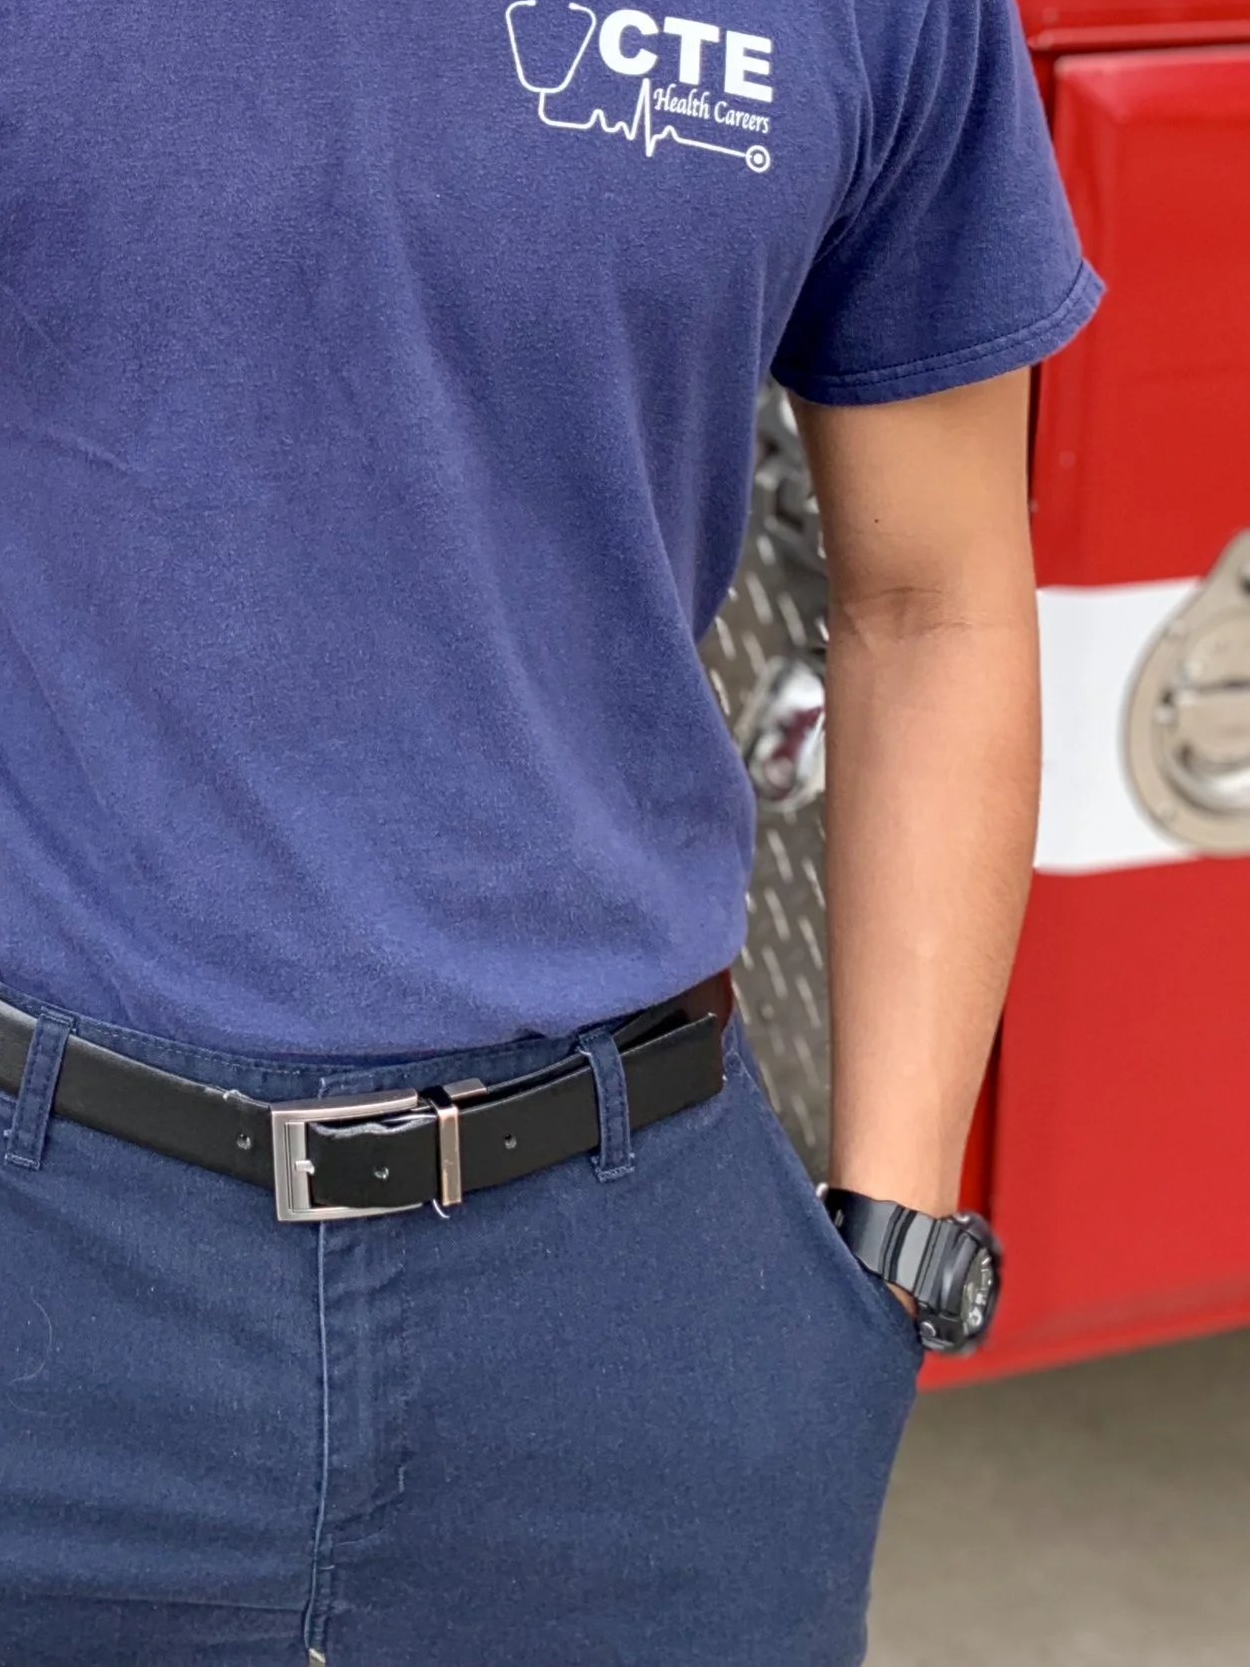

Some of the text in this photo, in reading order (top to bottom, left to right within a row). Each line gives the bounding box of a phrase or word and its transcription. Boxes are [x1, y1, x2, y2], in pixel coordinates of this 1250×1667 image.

[599, 9, 773, 103] CTE
[653, 84, 770, 134] Health Careers
